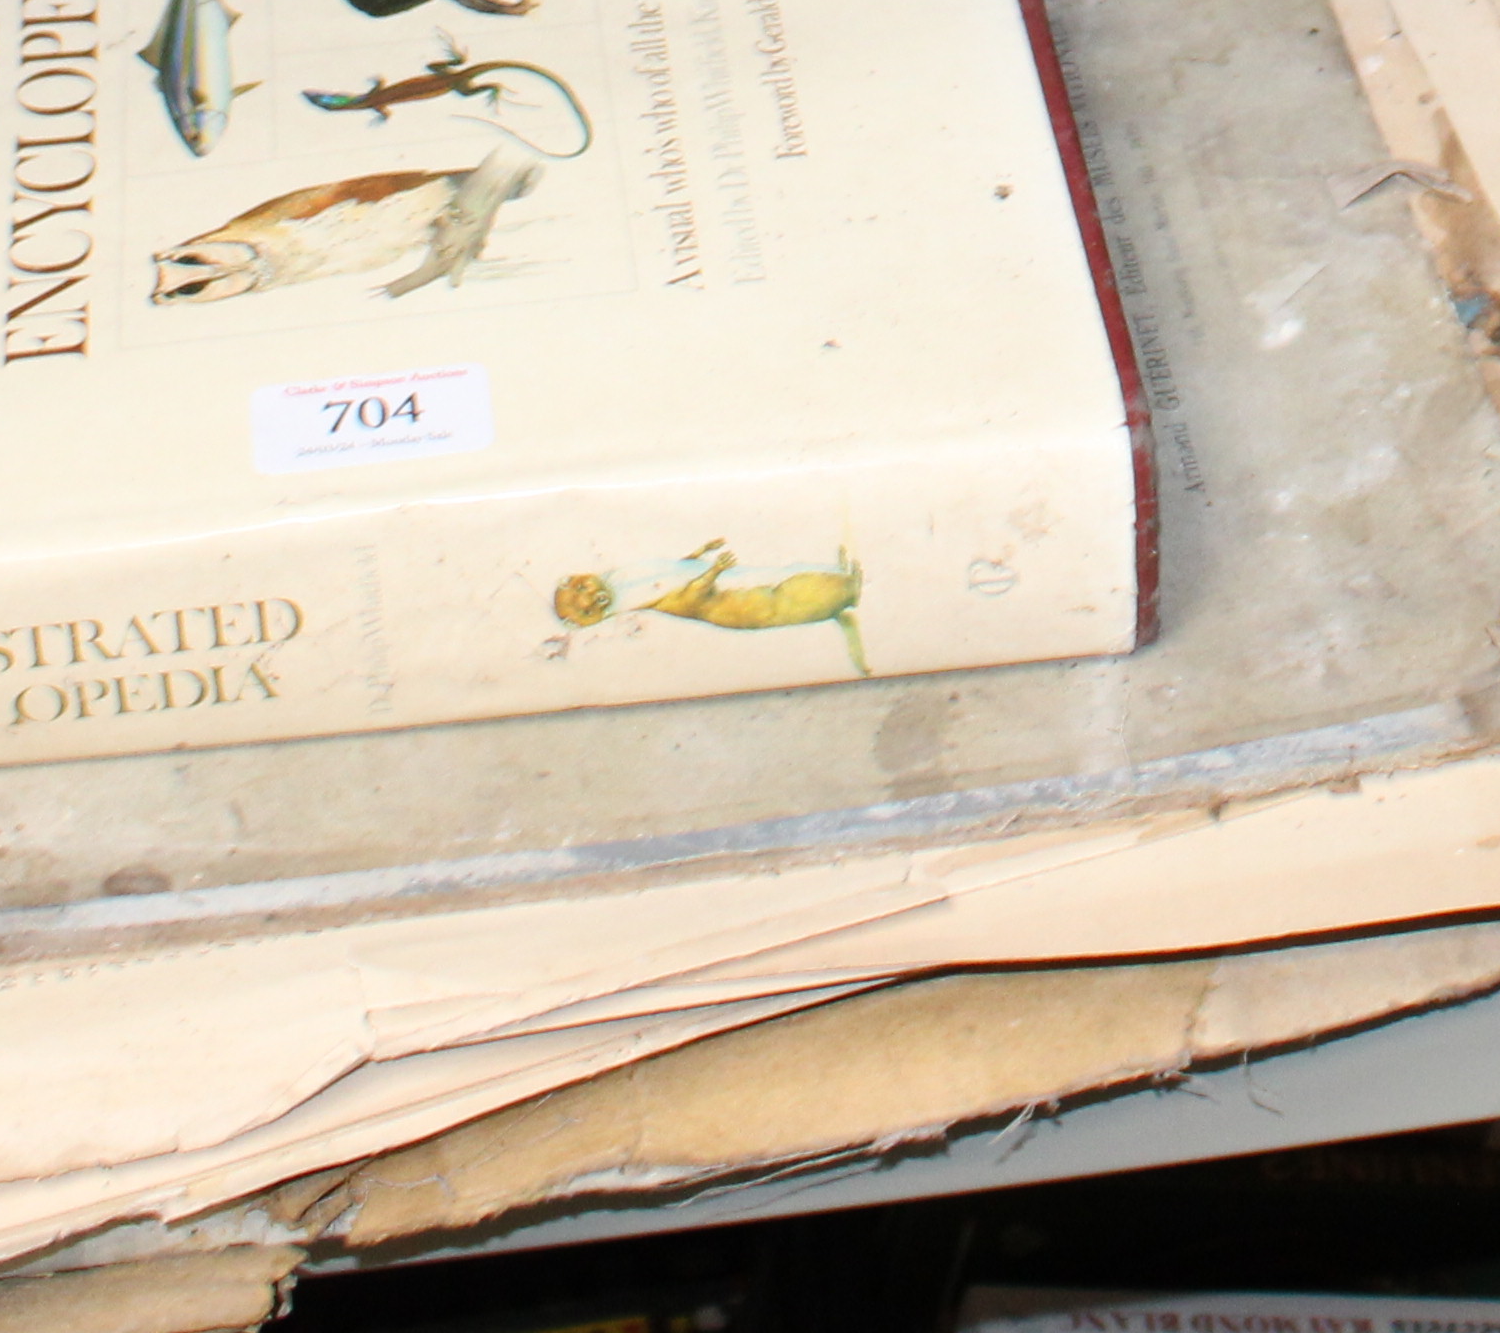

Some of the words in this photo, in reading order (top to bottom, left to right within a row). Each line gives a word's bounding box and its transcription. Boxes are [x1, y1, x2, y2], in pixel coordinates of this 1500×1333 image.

[626, 2, 665, 35] the
[629, 37, 668, 62] all
[759, 56, 791, 76] by
[633, 67, 671, 87] of
[638, 90, 679, 136] who
[762, 77, 808, 160] Foreword
[643, 137, 688, 195] who's
[652, 201, 698, 266] visual
[665, 267, 705, 290] A
[321, 390, 425, 435] 704
